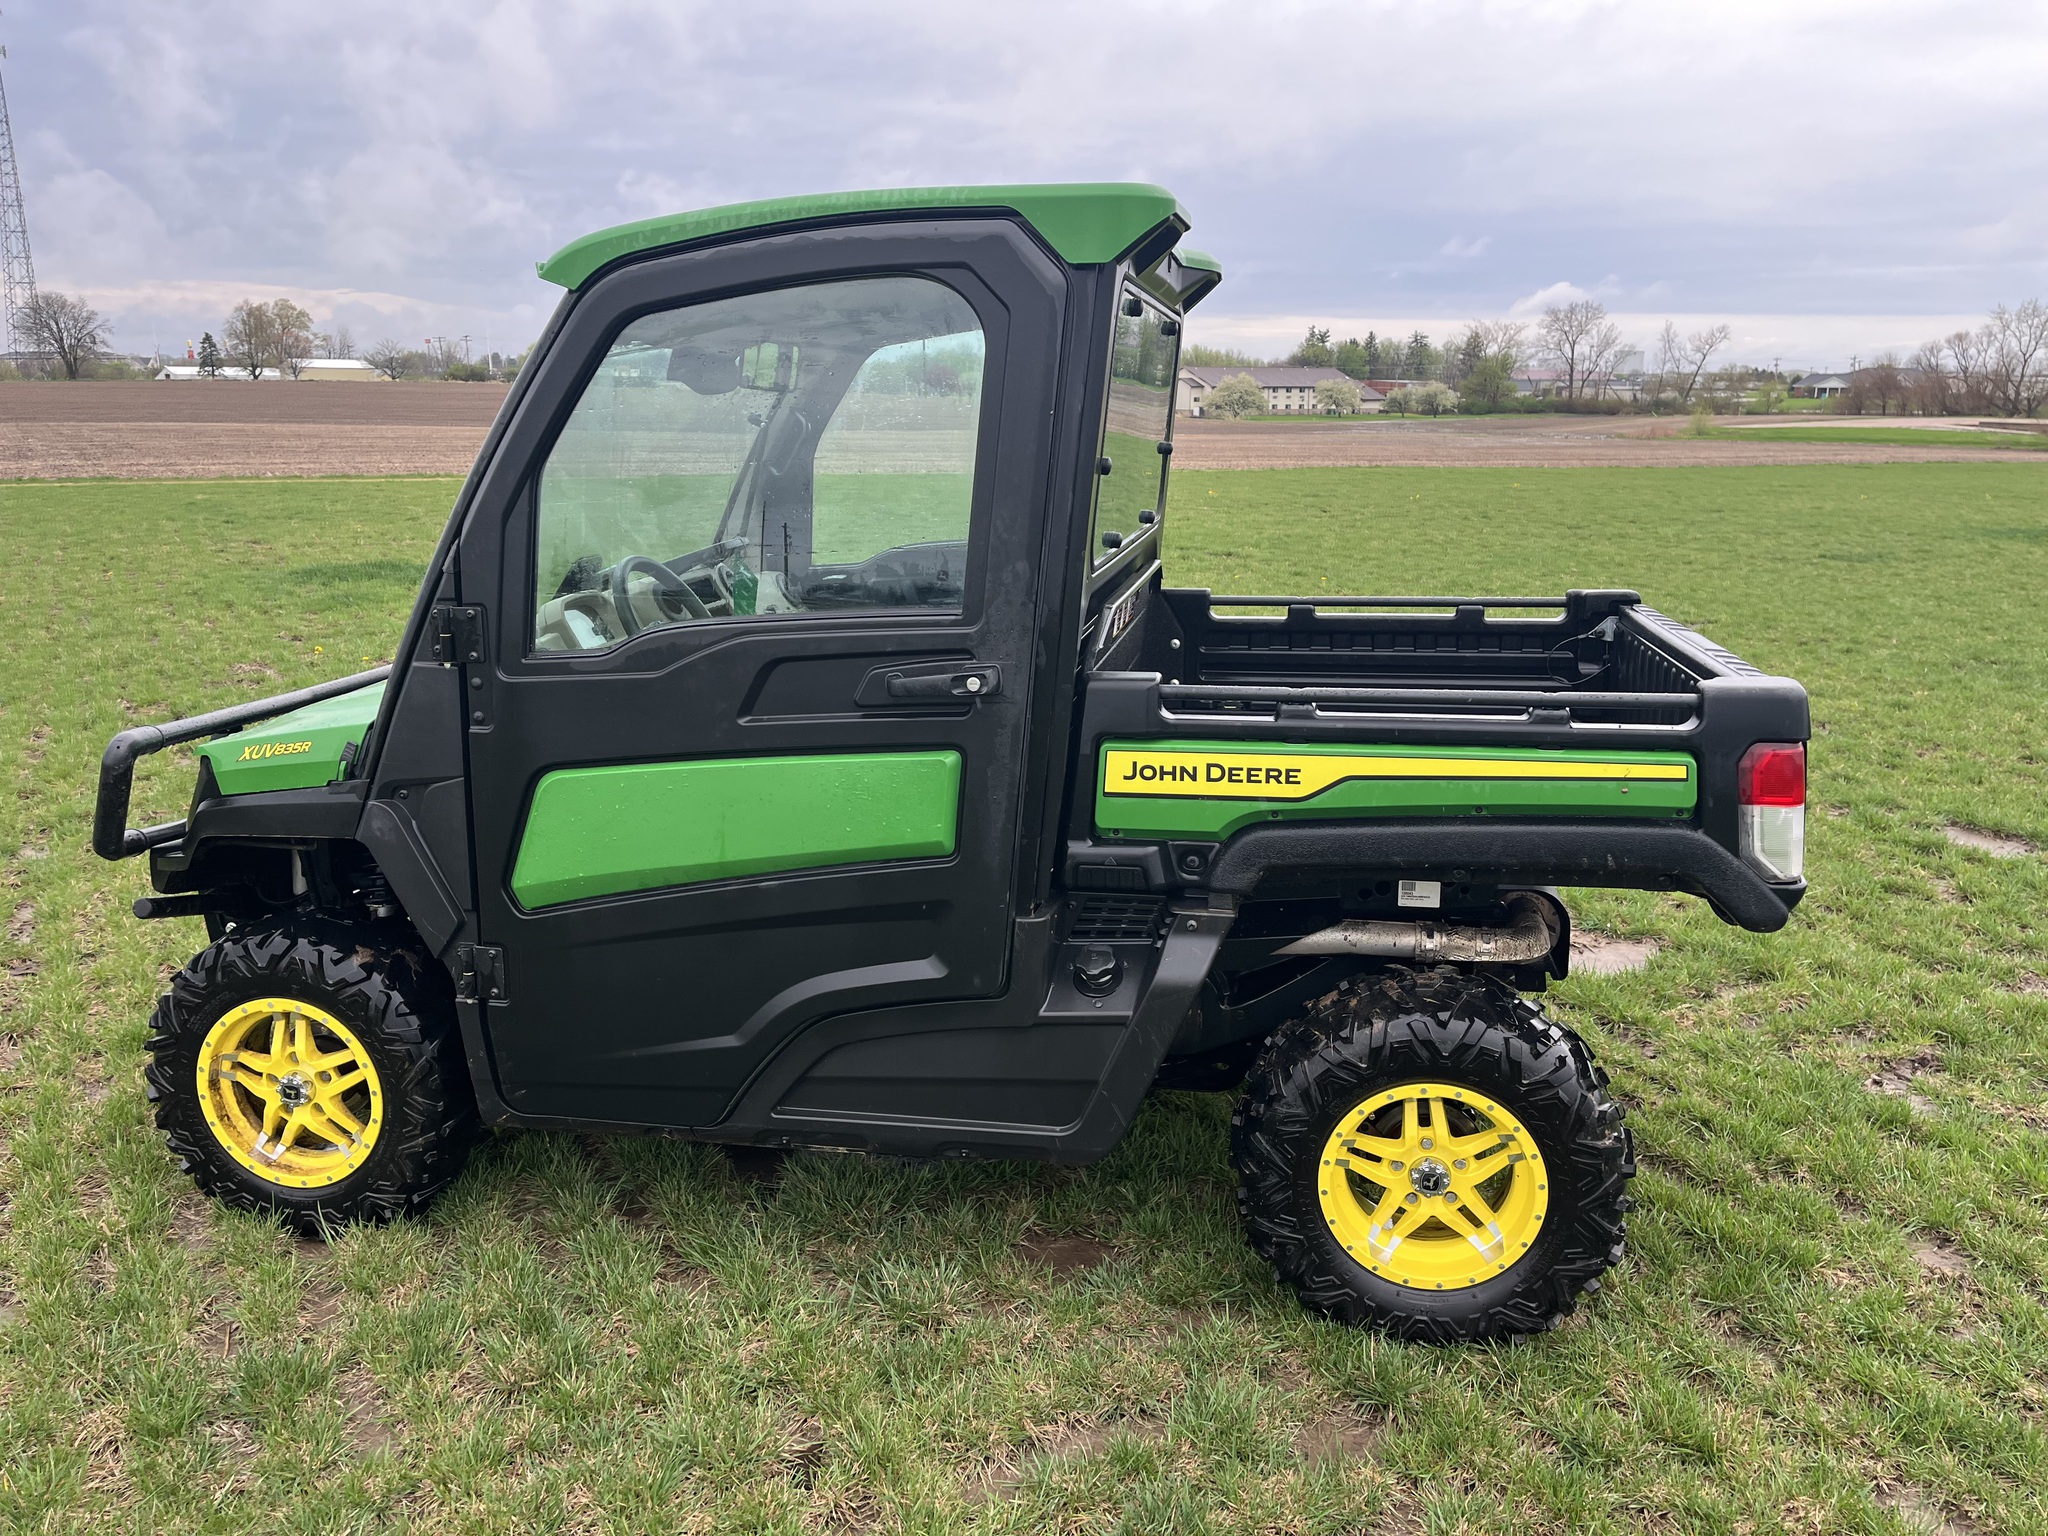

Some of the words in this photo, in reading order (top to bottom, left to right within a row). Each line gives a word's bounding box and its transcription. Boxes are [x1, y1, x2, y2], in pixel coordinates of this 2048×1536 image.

[237, 740, 312, 762] XUV835R
[1123, 761, 1198, 782] JOHN
[1206, 763, 1302, 785] DEERE
